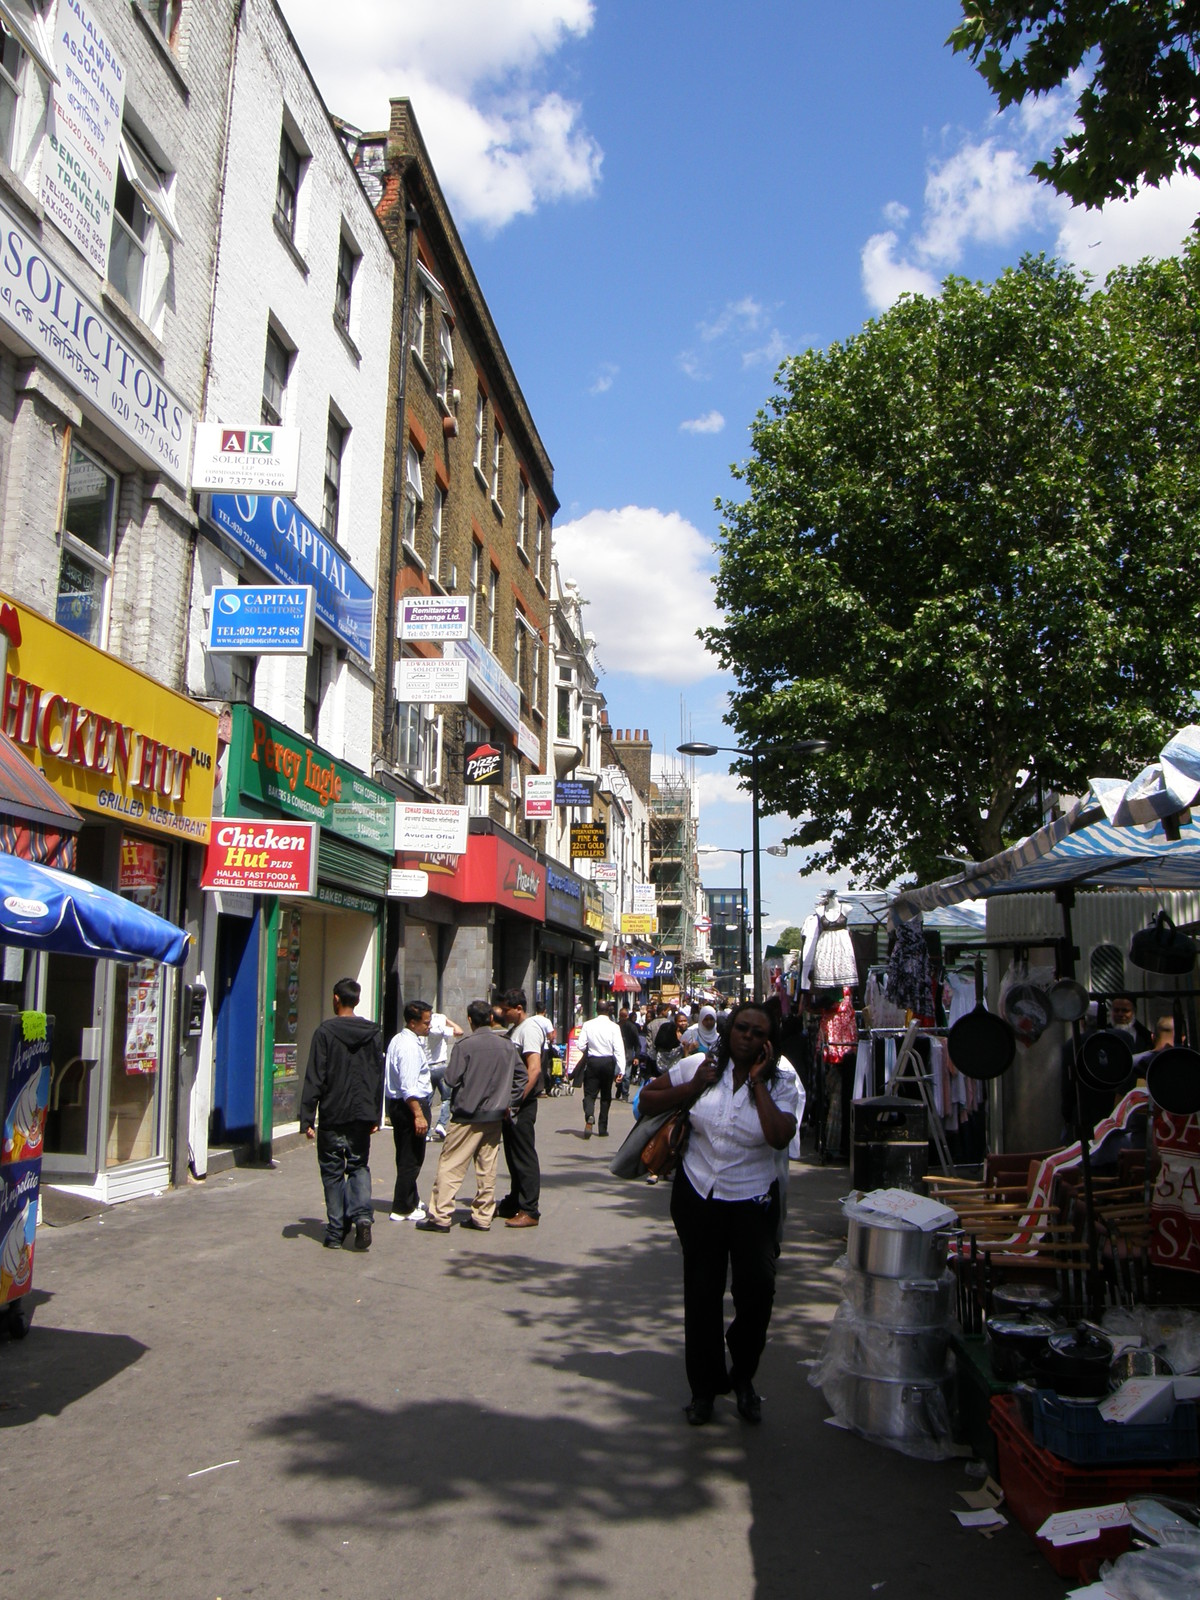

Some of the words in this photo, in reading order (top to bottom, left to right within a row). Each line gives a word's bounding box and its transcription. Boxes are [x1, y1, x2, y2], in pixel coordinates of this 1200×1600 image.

[82, 35, 104, 72] LAW
[62, 32, 120, 118] ASSOCIATES
[53, 98, 82, 140] TEL:020
[83, 135, 98, 161] 7247
[98, 156, 112, 182] 8070
[50, 134, 92, 193] BENGAL
[94, 186, 111, 217] AIR
[57, 163, 101, 226] TRAVELS
[45, 175, 74, 213] TEL:020
[76, 209, 90, 234] 7375
[92, 228, 106, 252] 3291
[42, 189, 73, 230] FAX:020
[74, 225, 88, 249] 7655
[90, 246, 106, 268] 0950
[4, 230, 182, 442] SOLICITORS
[111, 391, 130, 421] 020
[134, 412, 154, 446] 7377
[158, 437, 180, 470] 9366
[212, 455, 281, 466] SOLICITORS
[205, 476, 224, 484] 020
[230, 477, 254, 486] 7377
[258, 478, 284, 486] 9366
[272, 496, 352, 599] CAPITAL
[244, 594, 304, 605] CAPITAL
[244, 606, 302, 614] SOLICITORS
[410, 614, 446, 622] Exchange
[216, 626, 255, 636] TEL:020
[256, 626, 278, 636] 7247
[278, 627, 300, 636] 8458
[2, 672, 134, 785] HICKEN
[130, 732, 194, 803] HUT
[190, 746, 212, 770] PLUS
[251, 720, 302, 792] Percy
[304, 748, 342, 806] Ingle
[467, 755, 500, 775] Pizza
[473, 763, 497, 778] Hut
[98, 790, 144, 819] GRILLED
[148, 805, 208, 837] RESTAURANT
[268, 784, 286, 802] BAKERS
[292, 796, 325, 820] CONFECTIONERS
[436, 808, 460, 816] SOLICITORS
[217, 826, 305, 851] Chicken
[224, 847, 270, 868] Hut
[270, 861, 293, 869] PLUS
[213, 878, 246, 887] GRILLED
[247, 880, 300, 889] RESTAURANT
[217, 870, 242, 878] HALAL
[266, 872, 288, 880] FOOD
[320, 889, 343, 904] BAKED
[343, 895, 359, 908] HERE
[359, 899, 378, 912] TODAY
